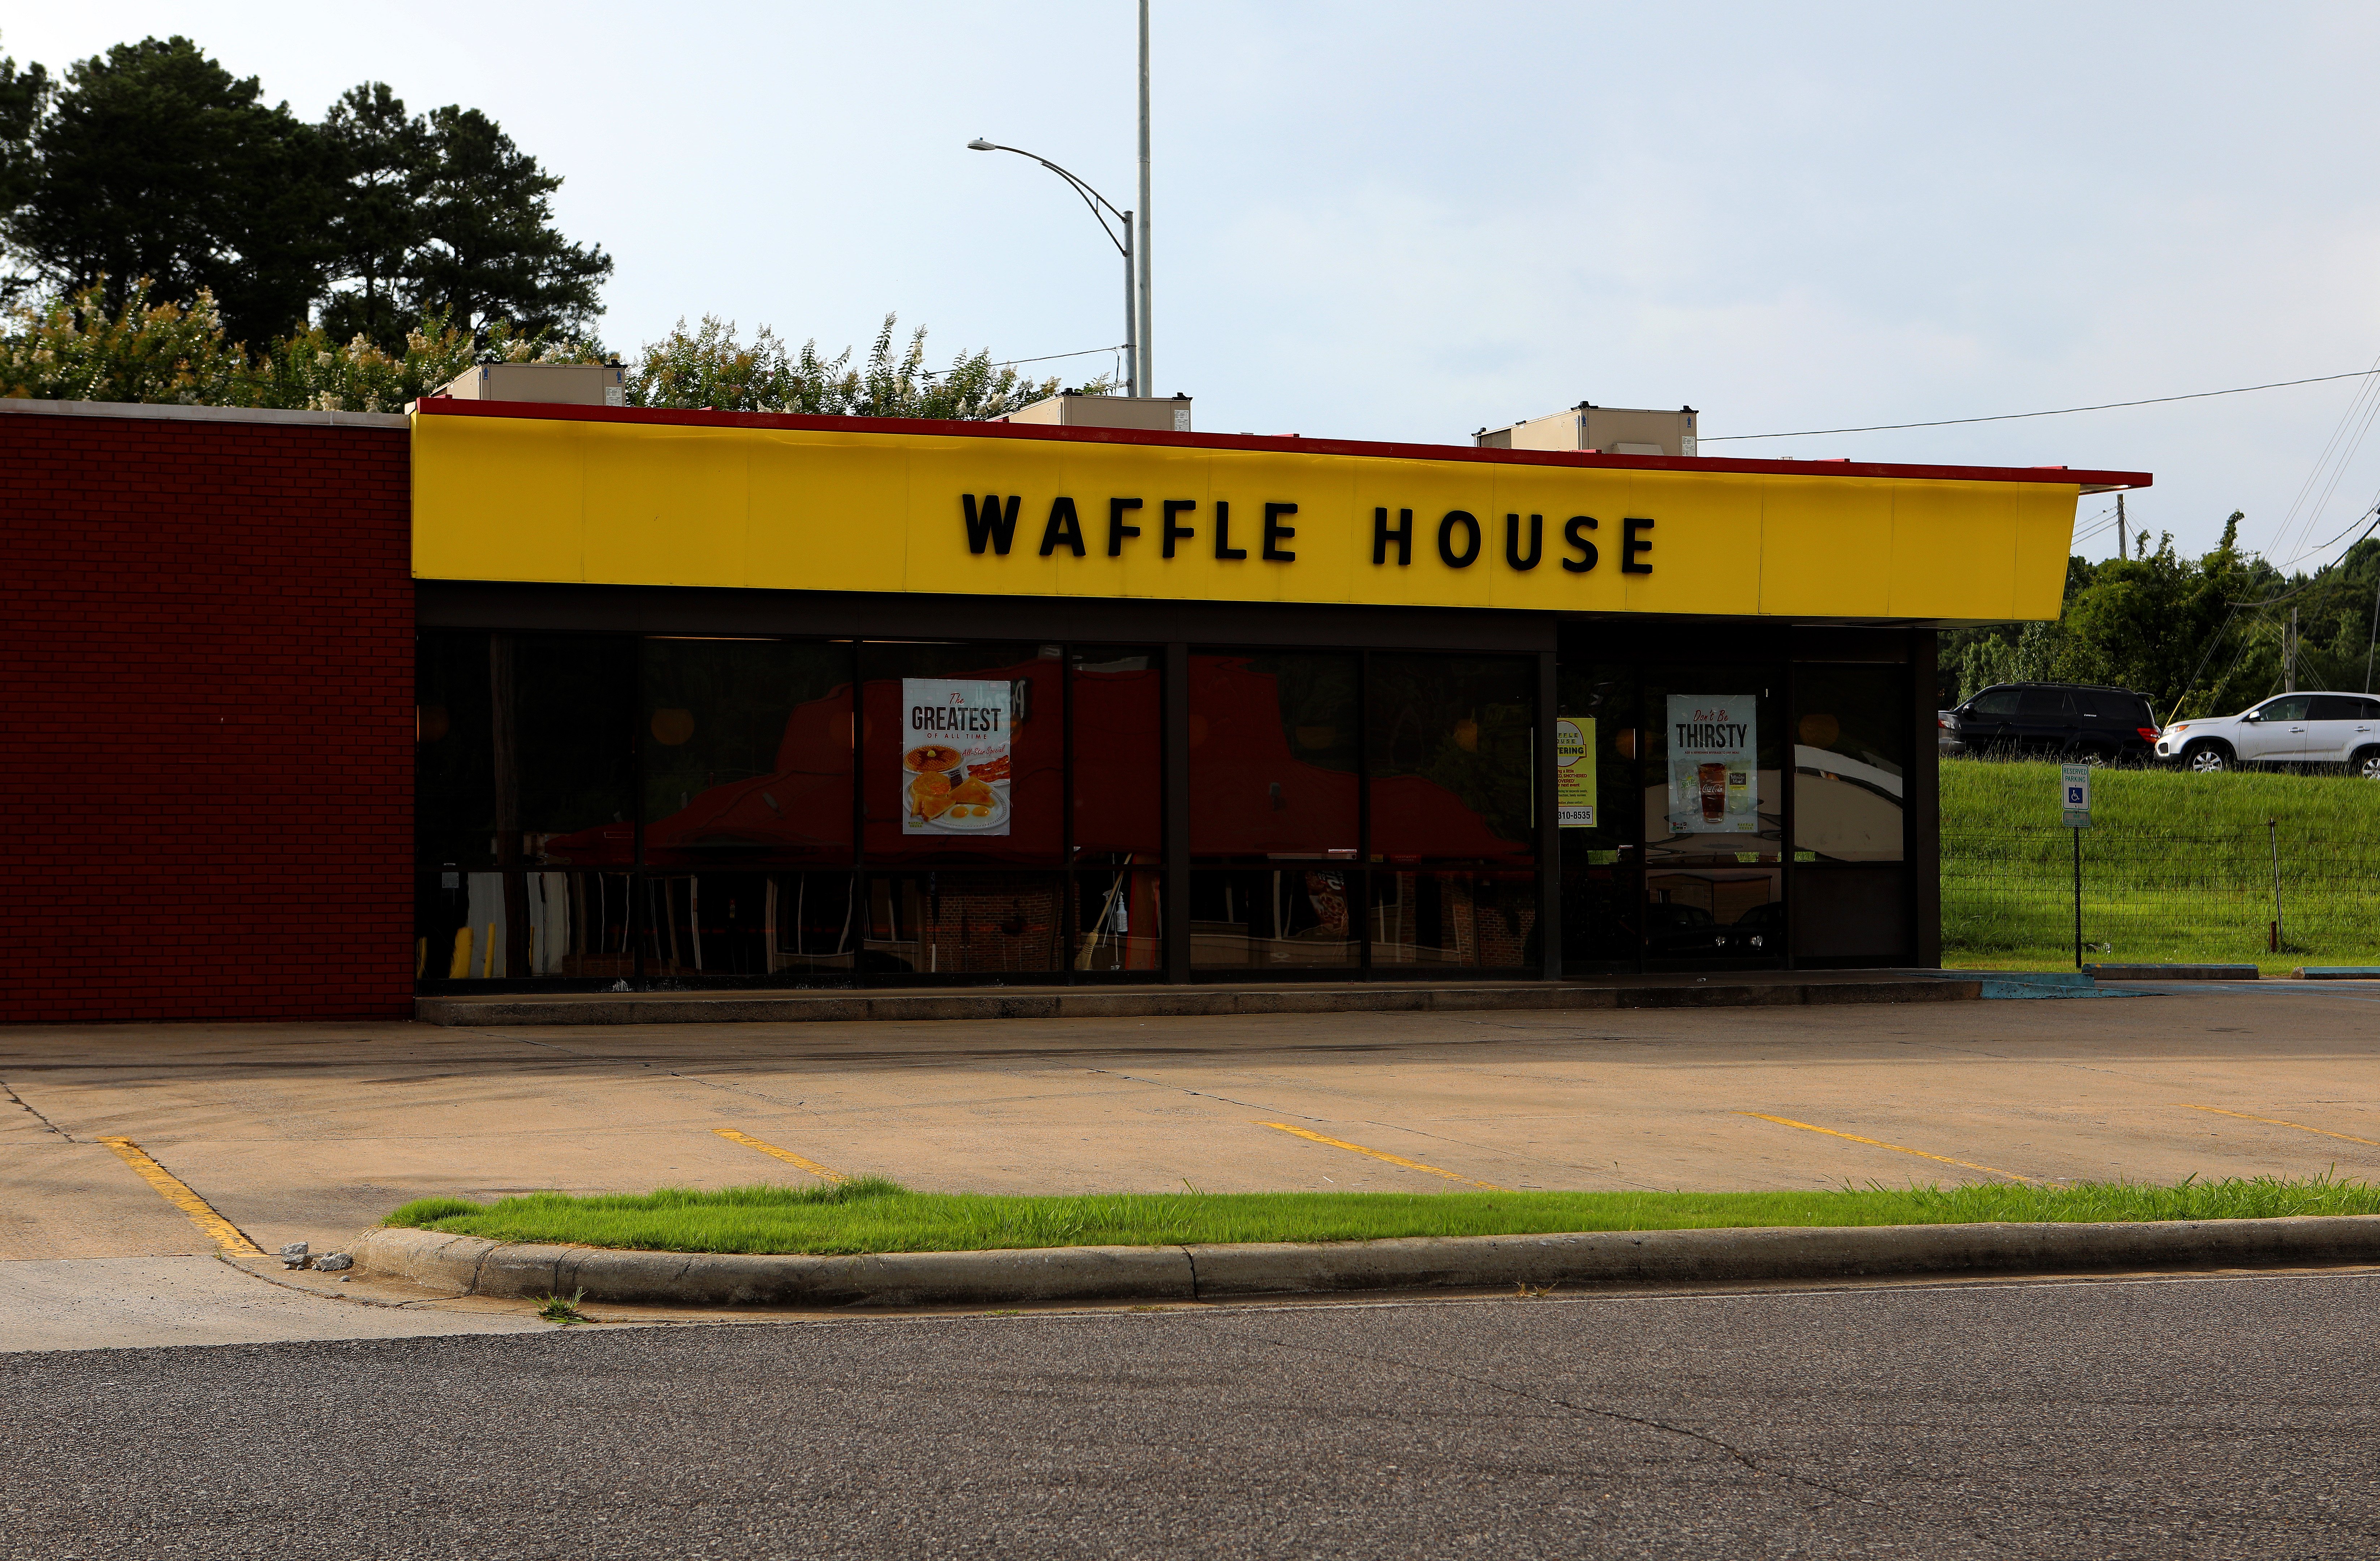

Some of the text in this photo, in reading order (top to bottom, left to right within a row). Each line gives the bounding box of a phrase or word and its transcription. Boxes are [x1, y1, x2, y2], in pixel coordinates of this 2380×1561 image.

[962, 494, 1654, 574] WAFFLE HOUSE
[949, 693, 965, 704] The
[912, 706, 1001, 732] GREATEST
[1693, 710, 1728, 722] Don't Be
[1676, 724, 1747, 748] THIRSTY
[961, 745, 1006, 757] All-Star Special
